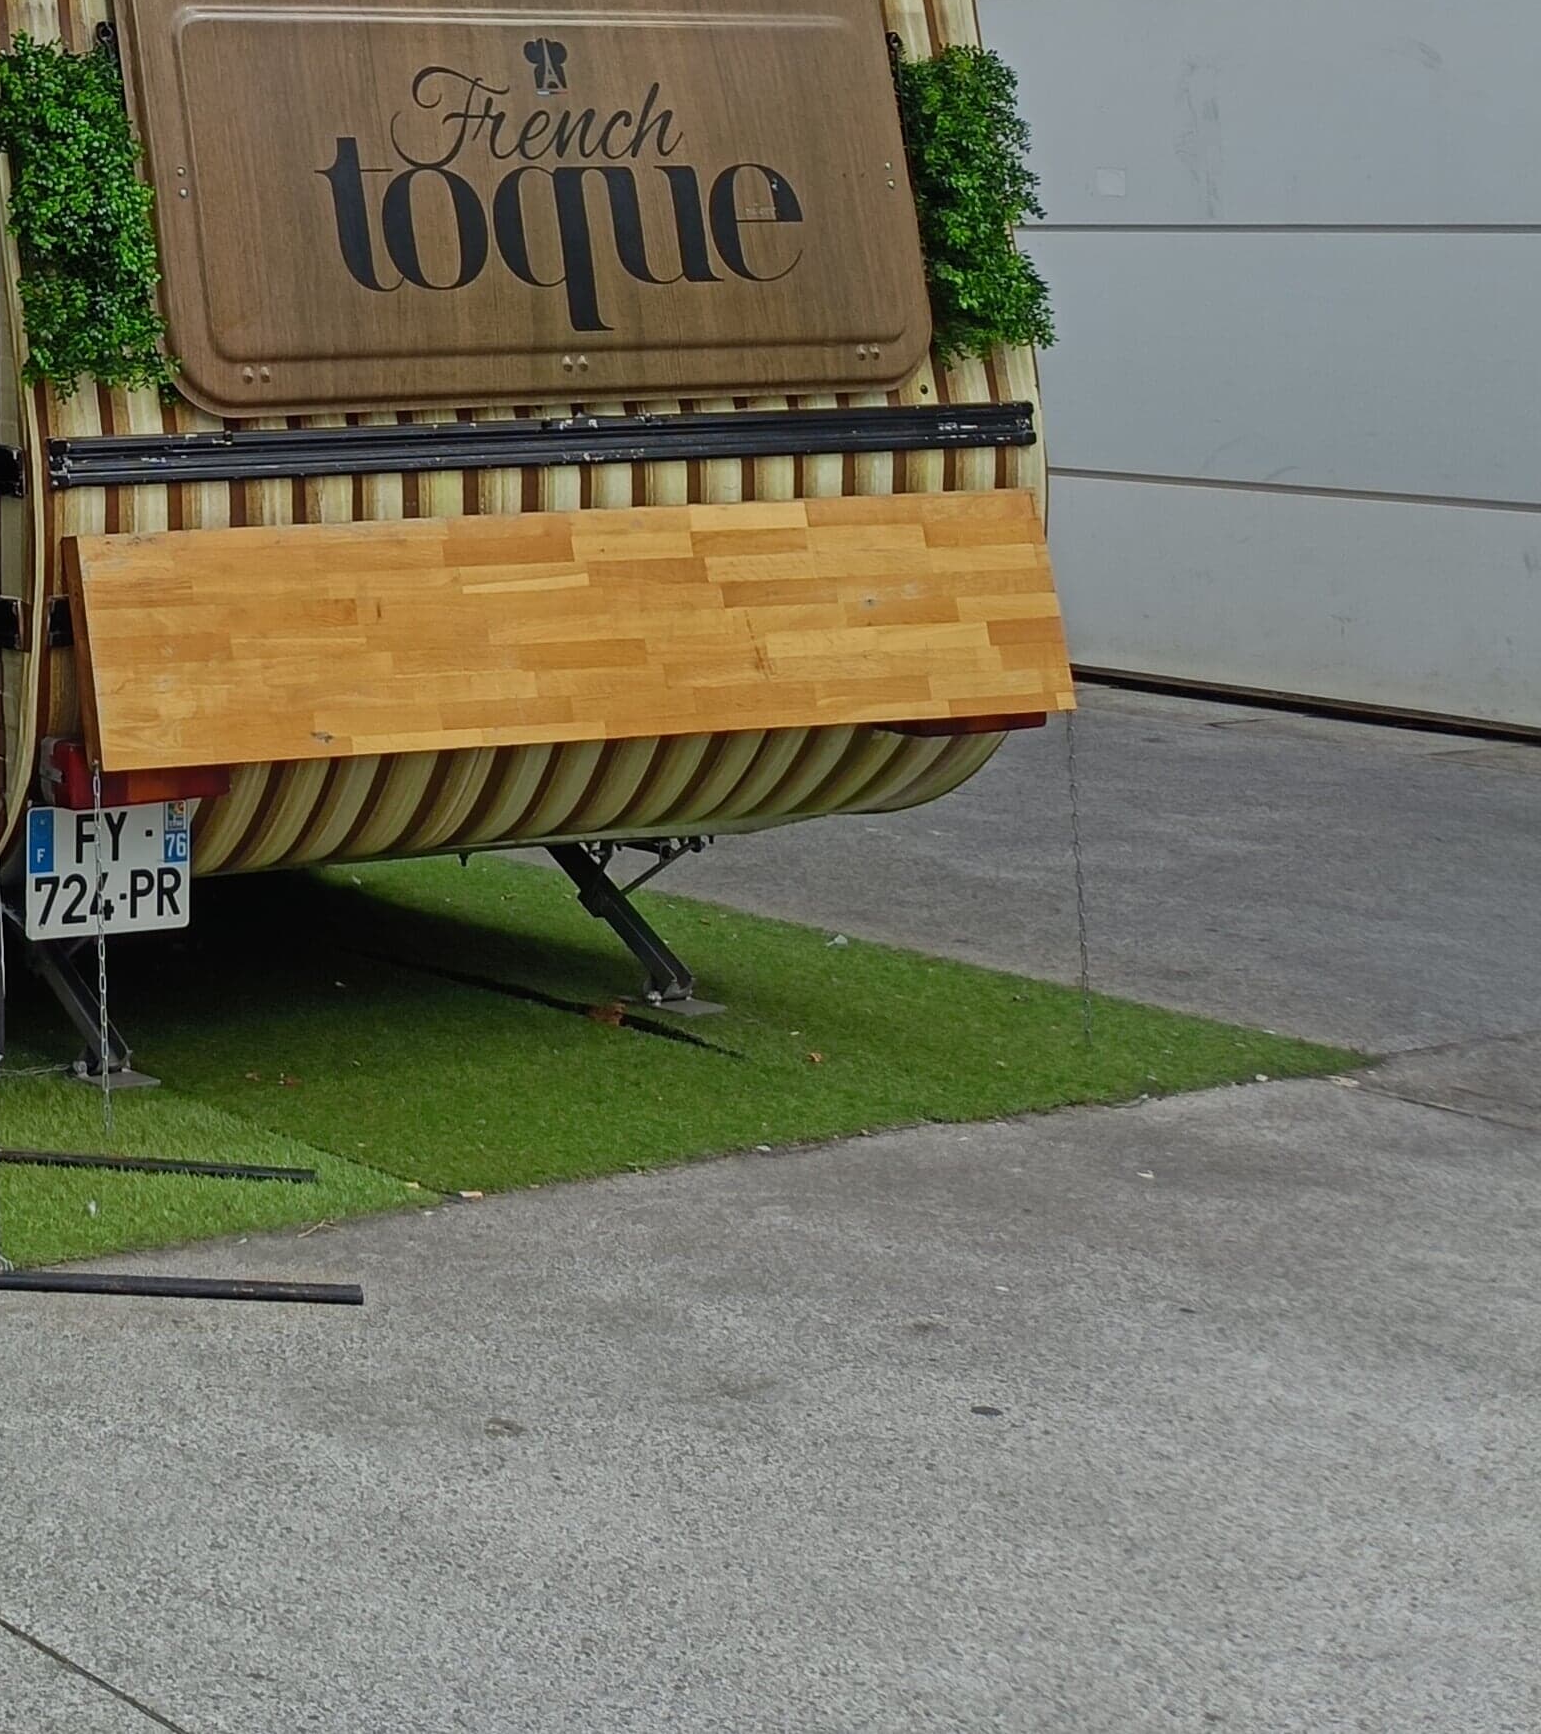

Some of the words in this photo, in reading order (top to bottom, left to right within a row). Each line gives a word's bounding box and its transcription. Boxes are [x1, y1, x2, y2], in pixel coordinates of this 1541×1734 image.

[390, 65, 684, 166] French
[315, 137, 804, 332] toque
[37, 848, 46, 863] F
[165, 832, 187, 857] 76
